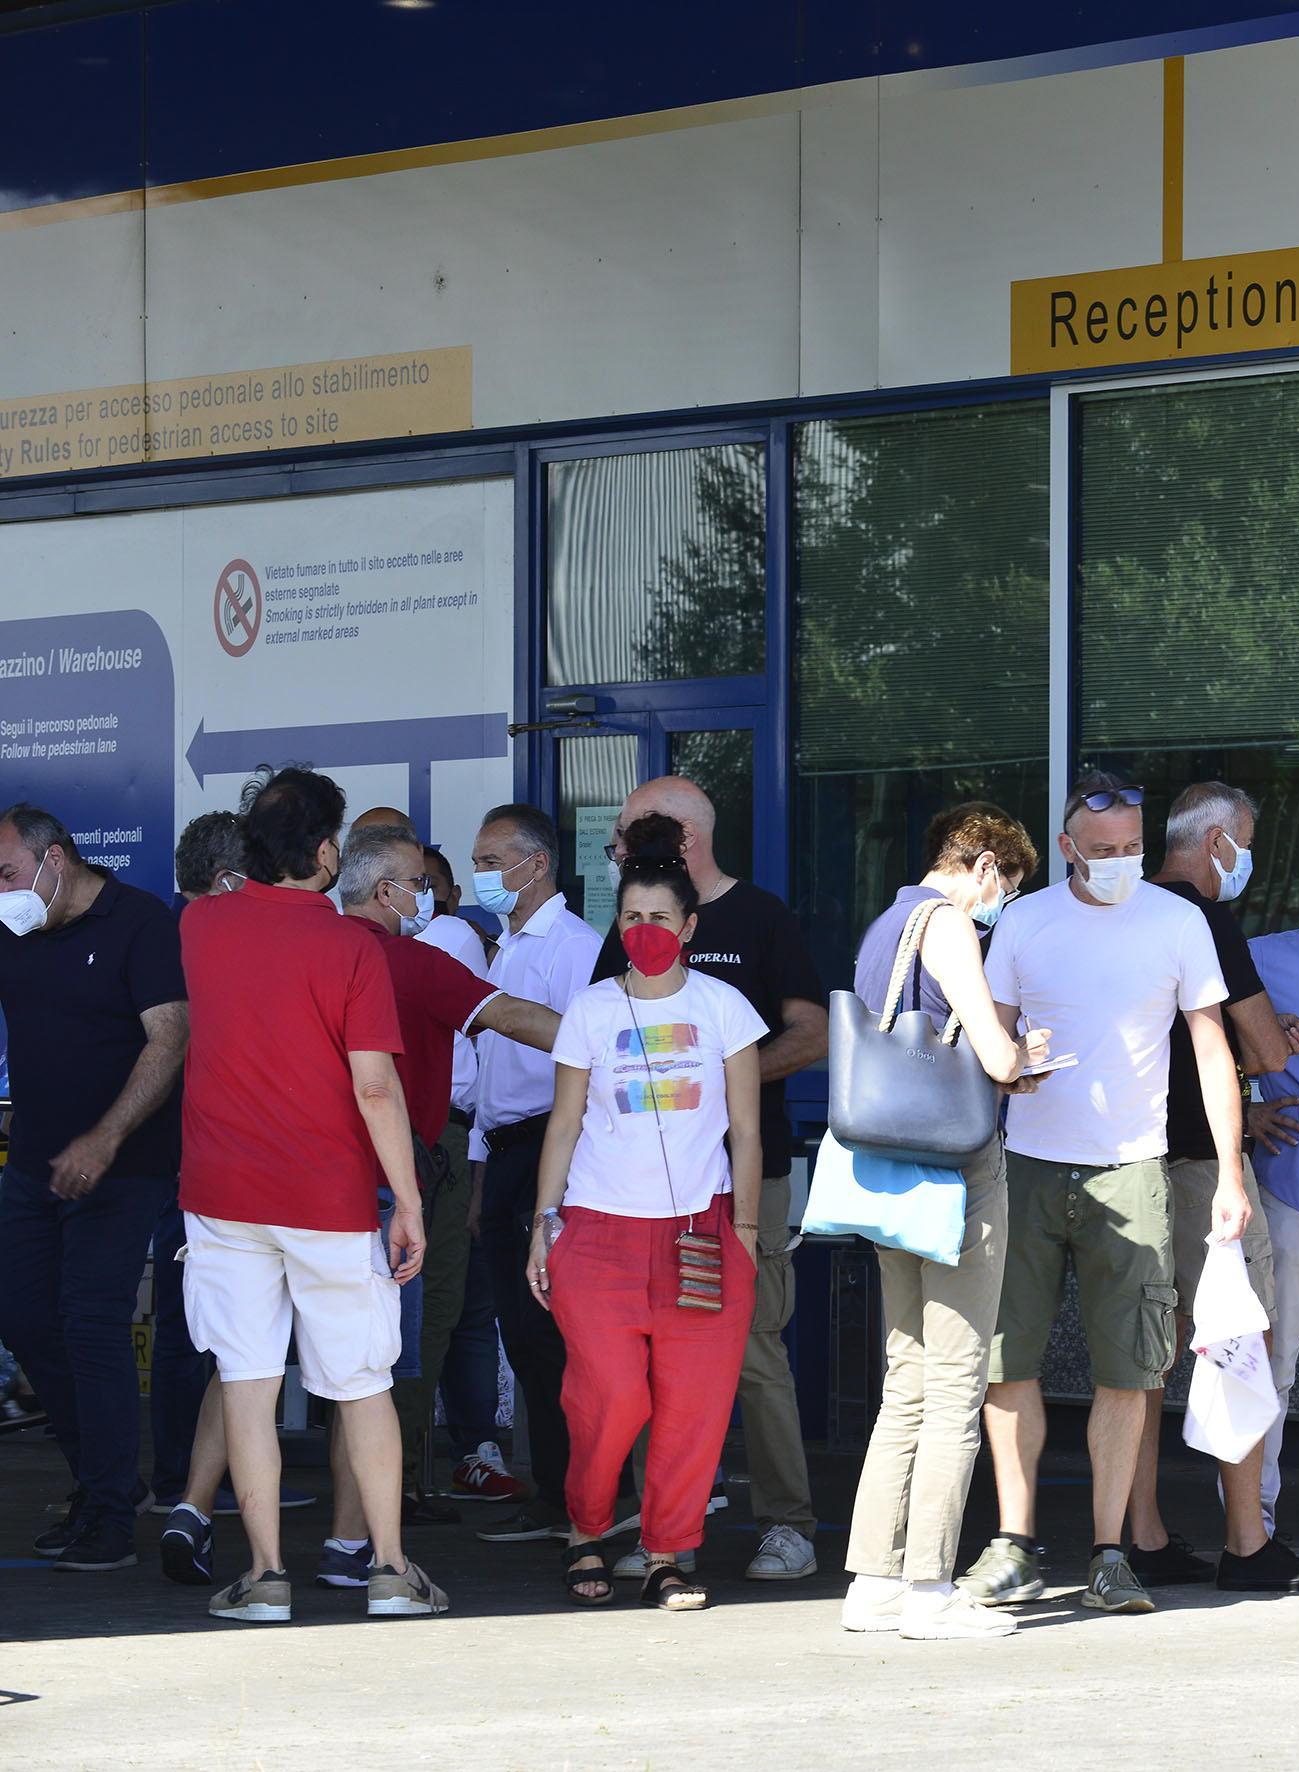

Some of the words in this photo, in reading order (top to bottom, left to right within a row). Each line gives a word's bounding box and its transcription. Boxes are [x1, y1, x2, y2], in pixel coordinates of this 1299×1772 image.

[1050, 271, 1297, 349] Reception
[65, 400, 93, 428] per
[100, 392, 172, 419] accesso
[180, 375, 264, 416] pedonale
[272, 371, 304, 400] allo
[312, 359, 430, 396] stabilimento
[21, 437, 71, 465] Rules
[78, 433, 101, 459] for
[109, 424, 202, 461] pedestrian
[210, 418, 273, 445] access
[281, 411, 298, 437] to
[306, 407, 338, 434] site
[265, 565, 294, 580] Vietato
[296, 563, 326, 577] fumare
[328, 560, 336, 574] in
[339, 559, 359, 573] tutto
[361, 556, 367, 571] il
[368, 555, 385, 571] sito
[387, 552, 419, 569] eccetto
[421, 549, 442, 566] nelle
[444, 549, 464, 563] aree
[265, 587, 297, 602] esterne
[299, 582, 340, 601] segnalate
[265, 607, 303, 624] Smoking
[305, 606, 313, 620] is
[315, 603, 345, 621] strictly
[346, 599, 388, 617] forbidden
[390, 598, 399, 613] in
[400, 596, 412, 612] all
[413, 594, 436, 614] plant
[437, 592, 467, 610] except
[468, 590, 478, 606] in
[265, 628, 300, 645] external
[301, 625, 334, 642] marked
[335, 626, 360, 639] areas
[59, 645, 143, 674] Warehouse
[0, 720, 25, 739] Segui
[27, 718, 33, 734] il
[35, 718, 75, 737] percorso
[76, 713, 119, 735] pedonale
[0, 742, 31, 759] Follow
[32, 741, 46, 757] the
[47, 738, 96, 760] pedestrian
[97, 738, 117, 753] lane
[103, 826, 143, 848] pedonali
[689, 952, 742, 964] OPERAIA
